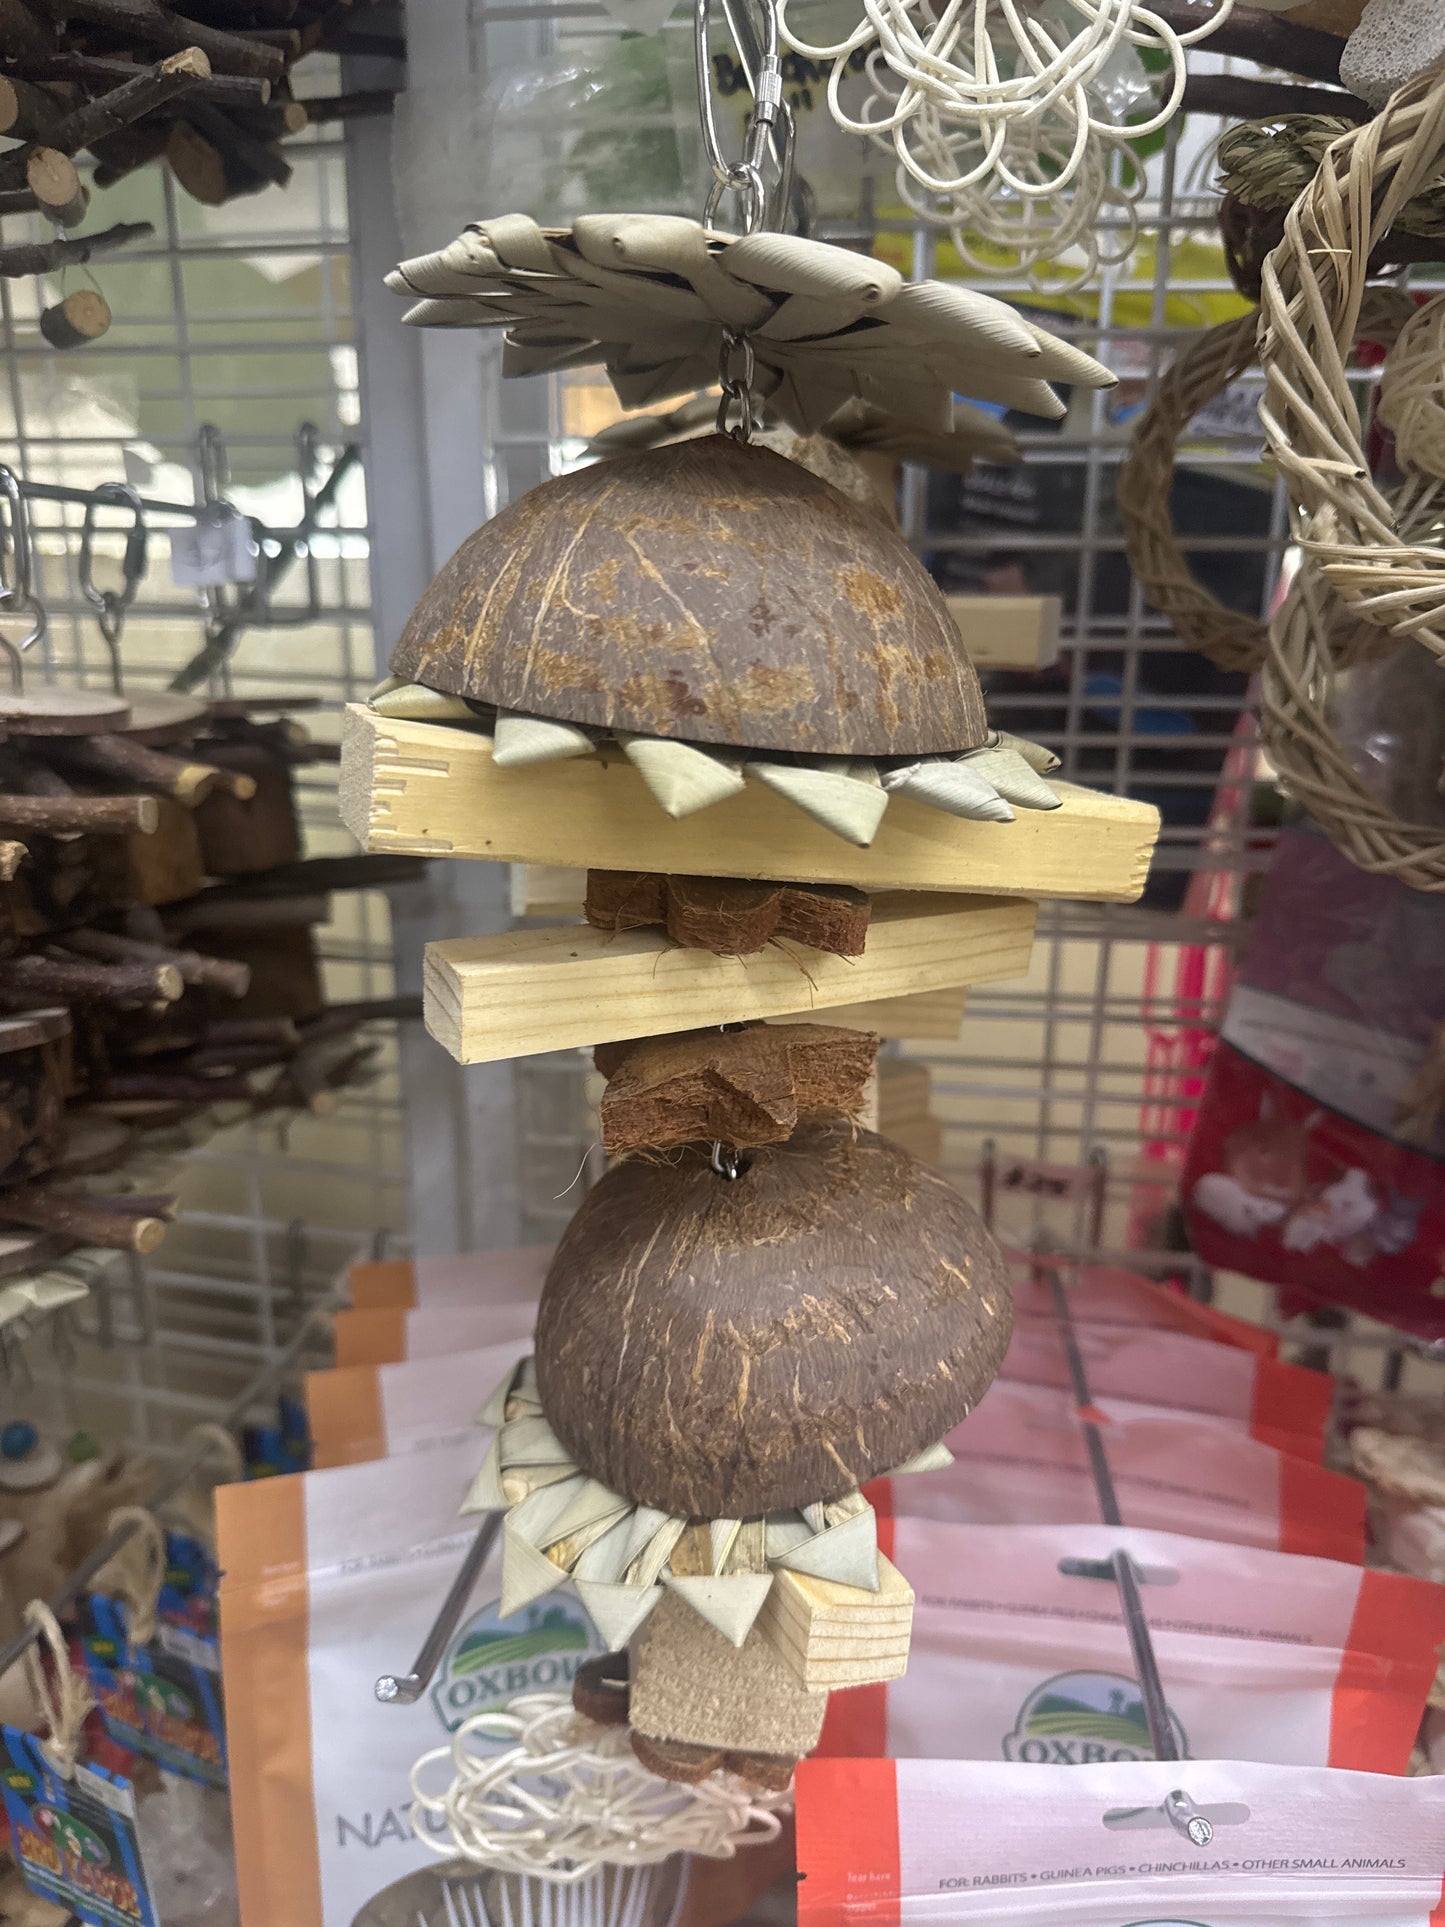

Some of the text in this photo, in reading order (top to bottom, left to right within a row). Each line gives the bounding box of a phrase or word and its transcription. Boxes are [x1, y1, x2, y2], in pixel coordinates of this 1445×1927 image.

[972, 1871, 1028, 1887] RABBITS
[1039, 1866, 1093, 1881] GUINEA
[1095, 1864, 1127, 1876] PIGS
[1138, 1860, 1230, 1874] CHINCHILLAS
[1242, 1858, 1290, 1870] OTHER
[1291, 1858, 1339, 1869] SMALL
[1341, 1857, 1407, 1869] ANIMALS
